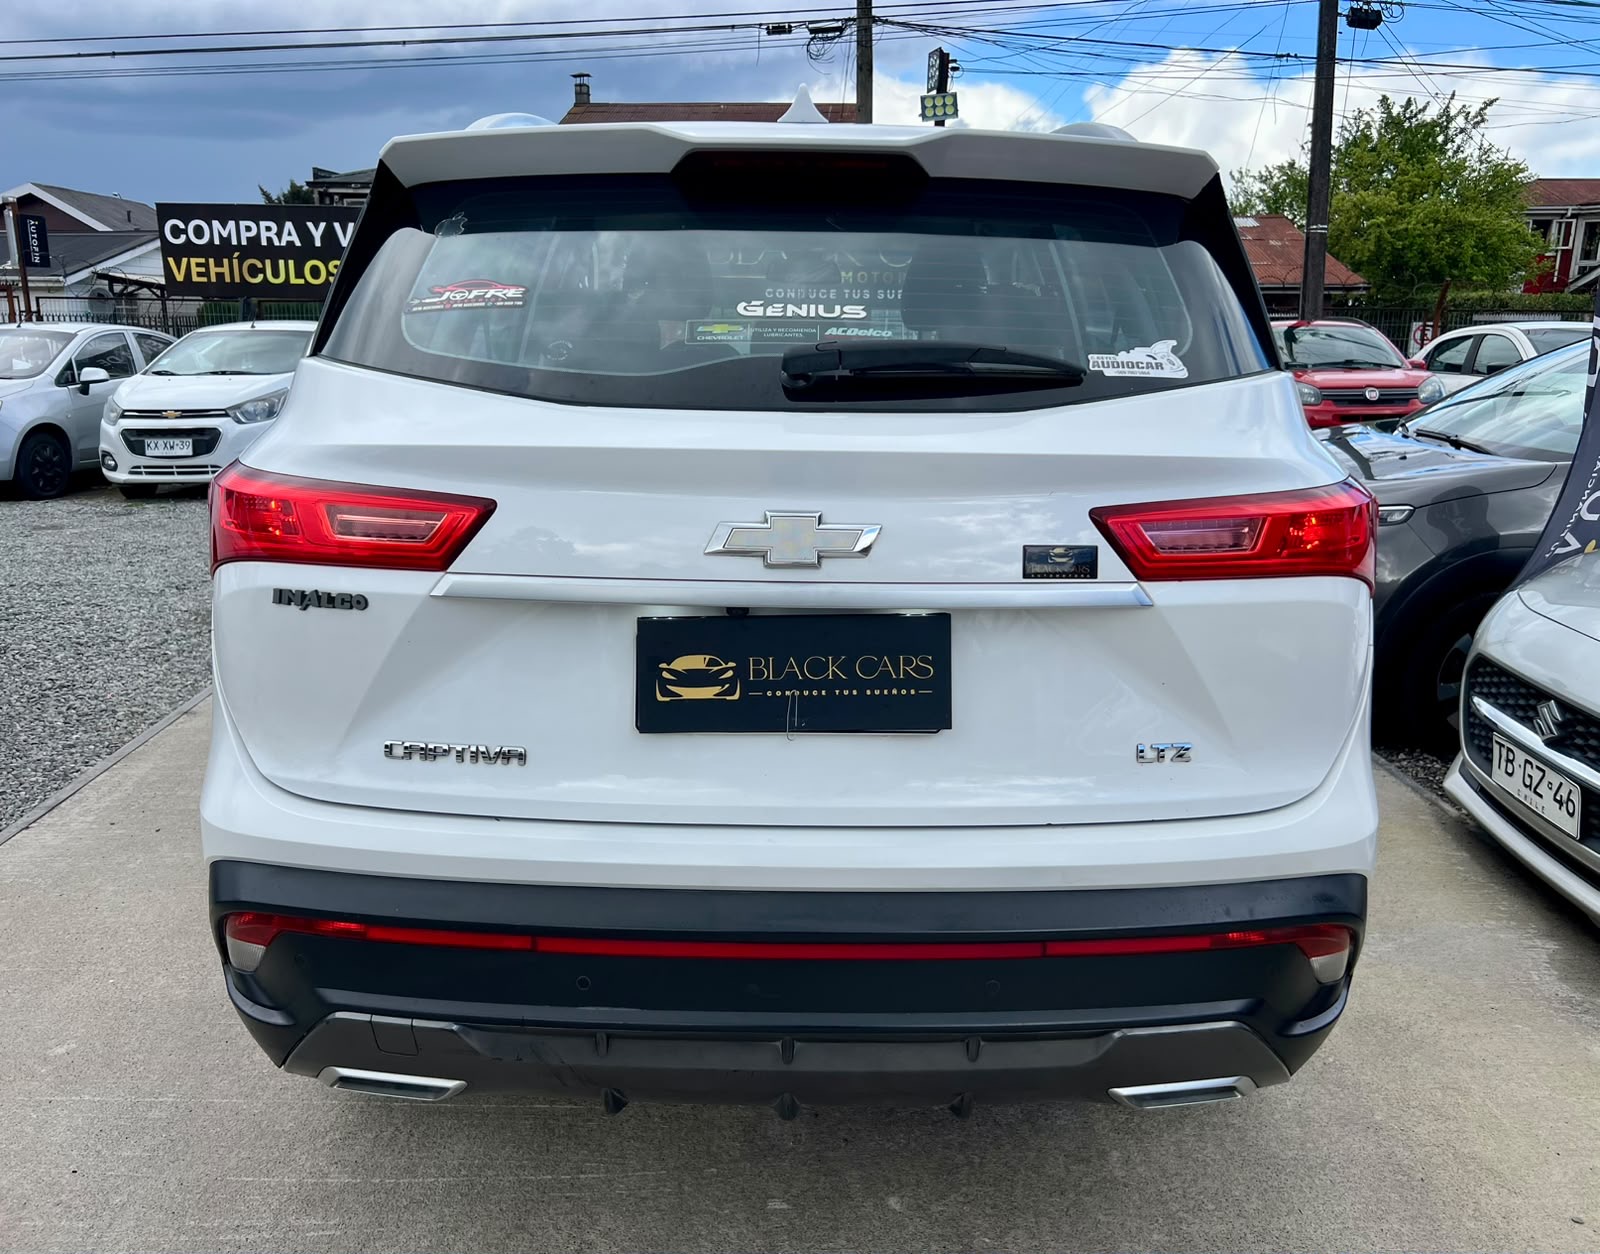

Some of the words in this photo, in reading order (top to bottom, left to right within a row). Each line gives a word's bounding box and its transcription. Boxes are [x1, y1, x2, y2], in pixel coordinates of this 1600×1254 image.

[29, 219, 41, 263] AUTOFIN
[163, 218, 302, 247] COMPRA
[306, 221, 327, 247] Y
[422, 288, 526, 301] JOFRE
[764, 288, 837, 300] CONDUCE
[843, 289, 871, 300] TUS
[735, 300, 868, 319] GENIUS
[824, 327, 893, 337] ACDelco
[1091, 360, 1165, 371] AUDIOCAR
[272, 587, 369, 611] INALCO
[748, 656, 848, 681] BLACK
[855, 654, 934, 680] CARS
[866, 687, 916, 696] SUEÑOS
[383, 739, 527, 766] CAPTIVA
[1136, 742, 1193, 763] LTZ
